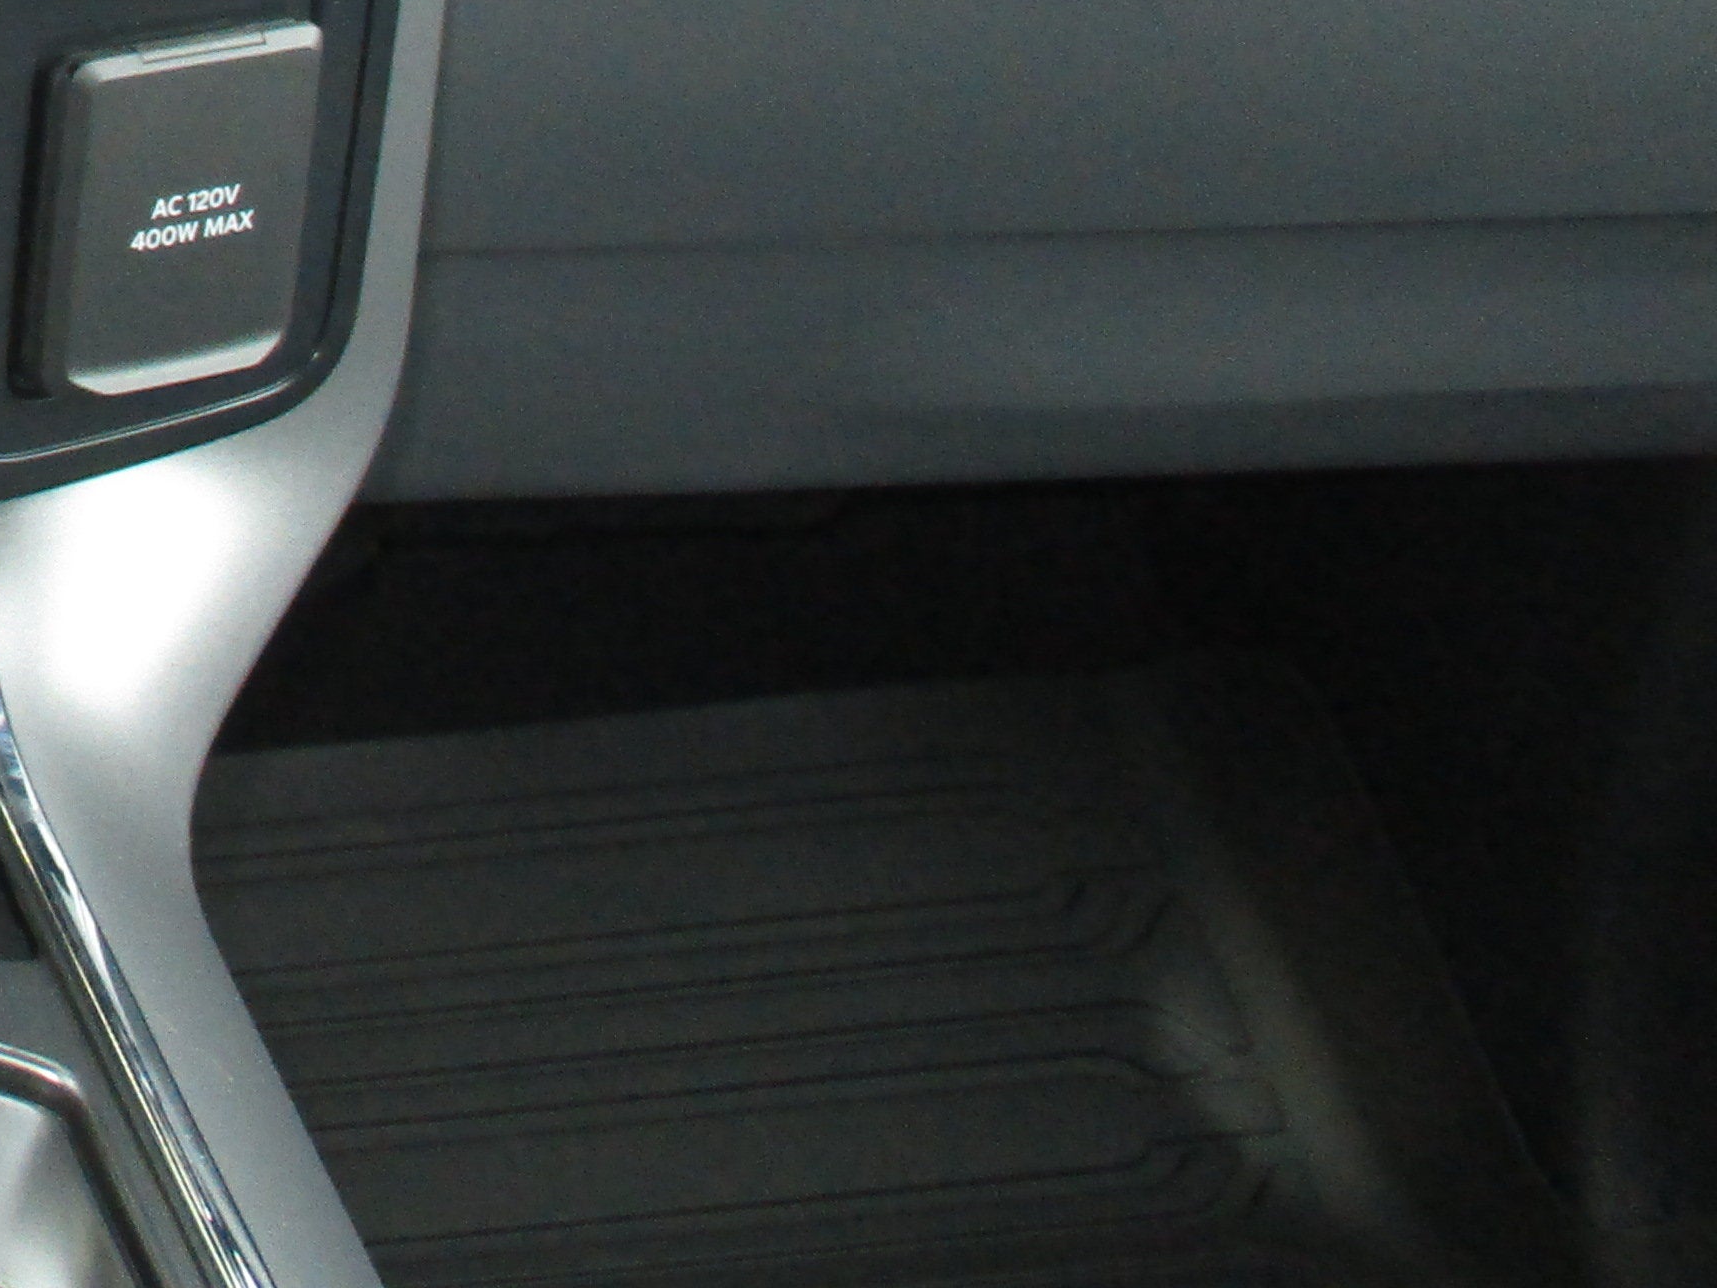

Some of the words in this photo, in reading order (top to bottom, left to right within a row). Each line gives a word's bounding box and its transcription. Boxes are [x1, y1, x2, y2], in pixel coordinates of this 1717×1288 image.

[150, 193, 185, 221] AC
[187, 182, 241, 215] 120V
[130, 220, 200, 253] 400W
[203, 207, 255, 239] MAX
